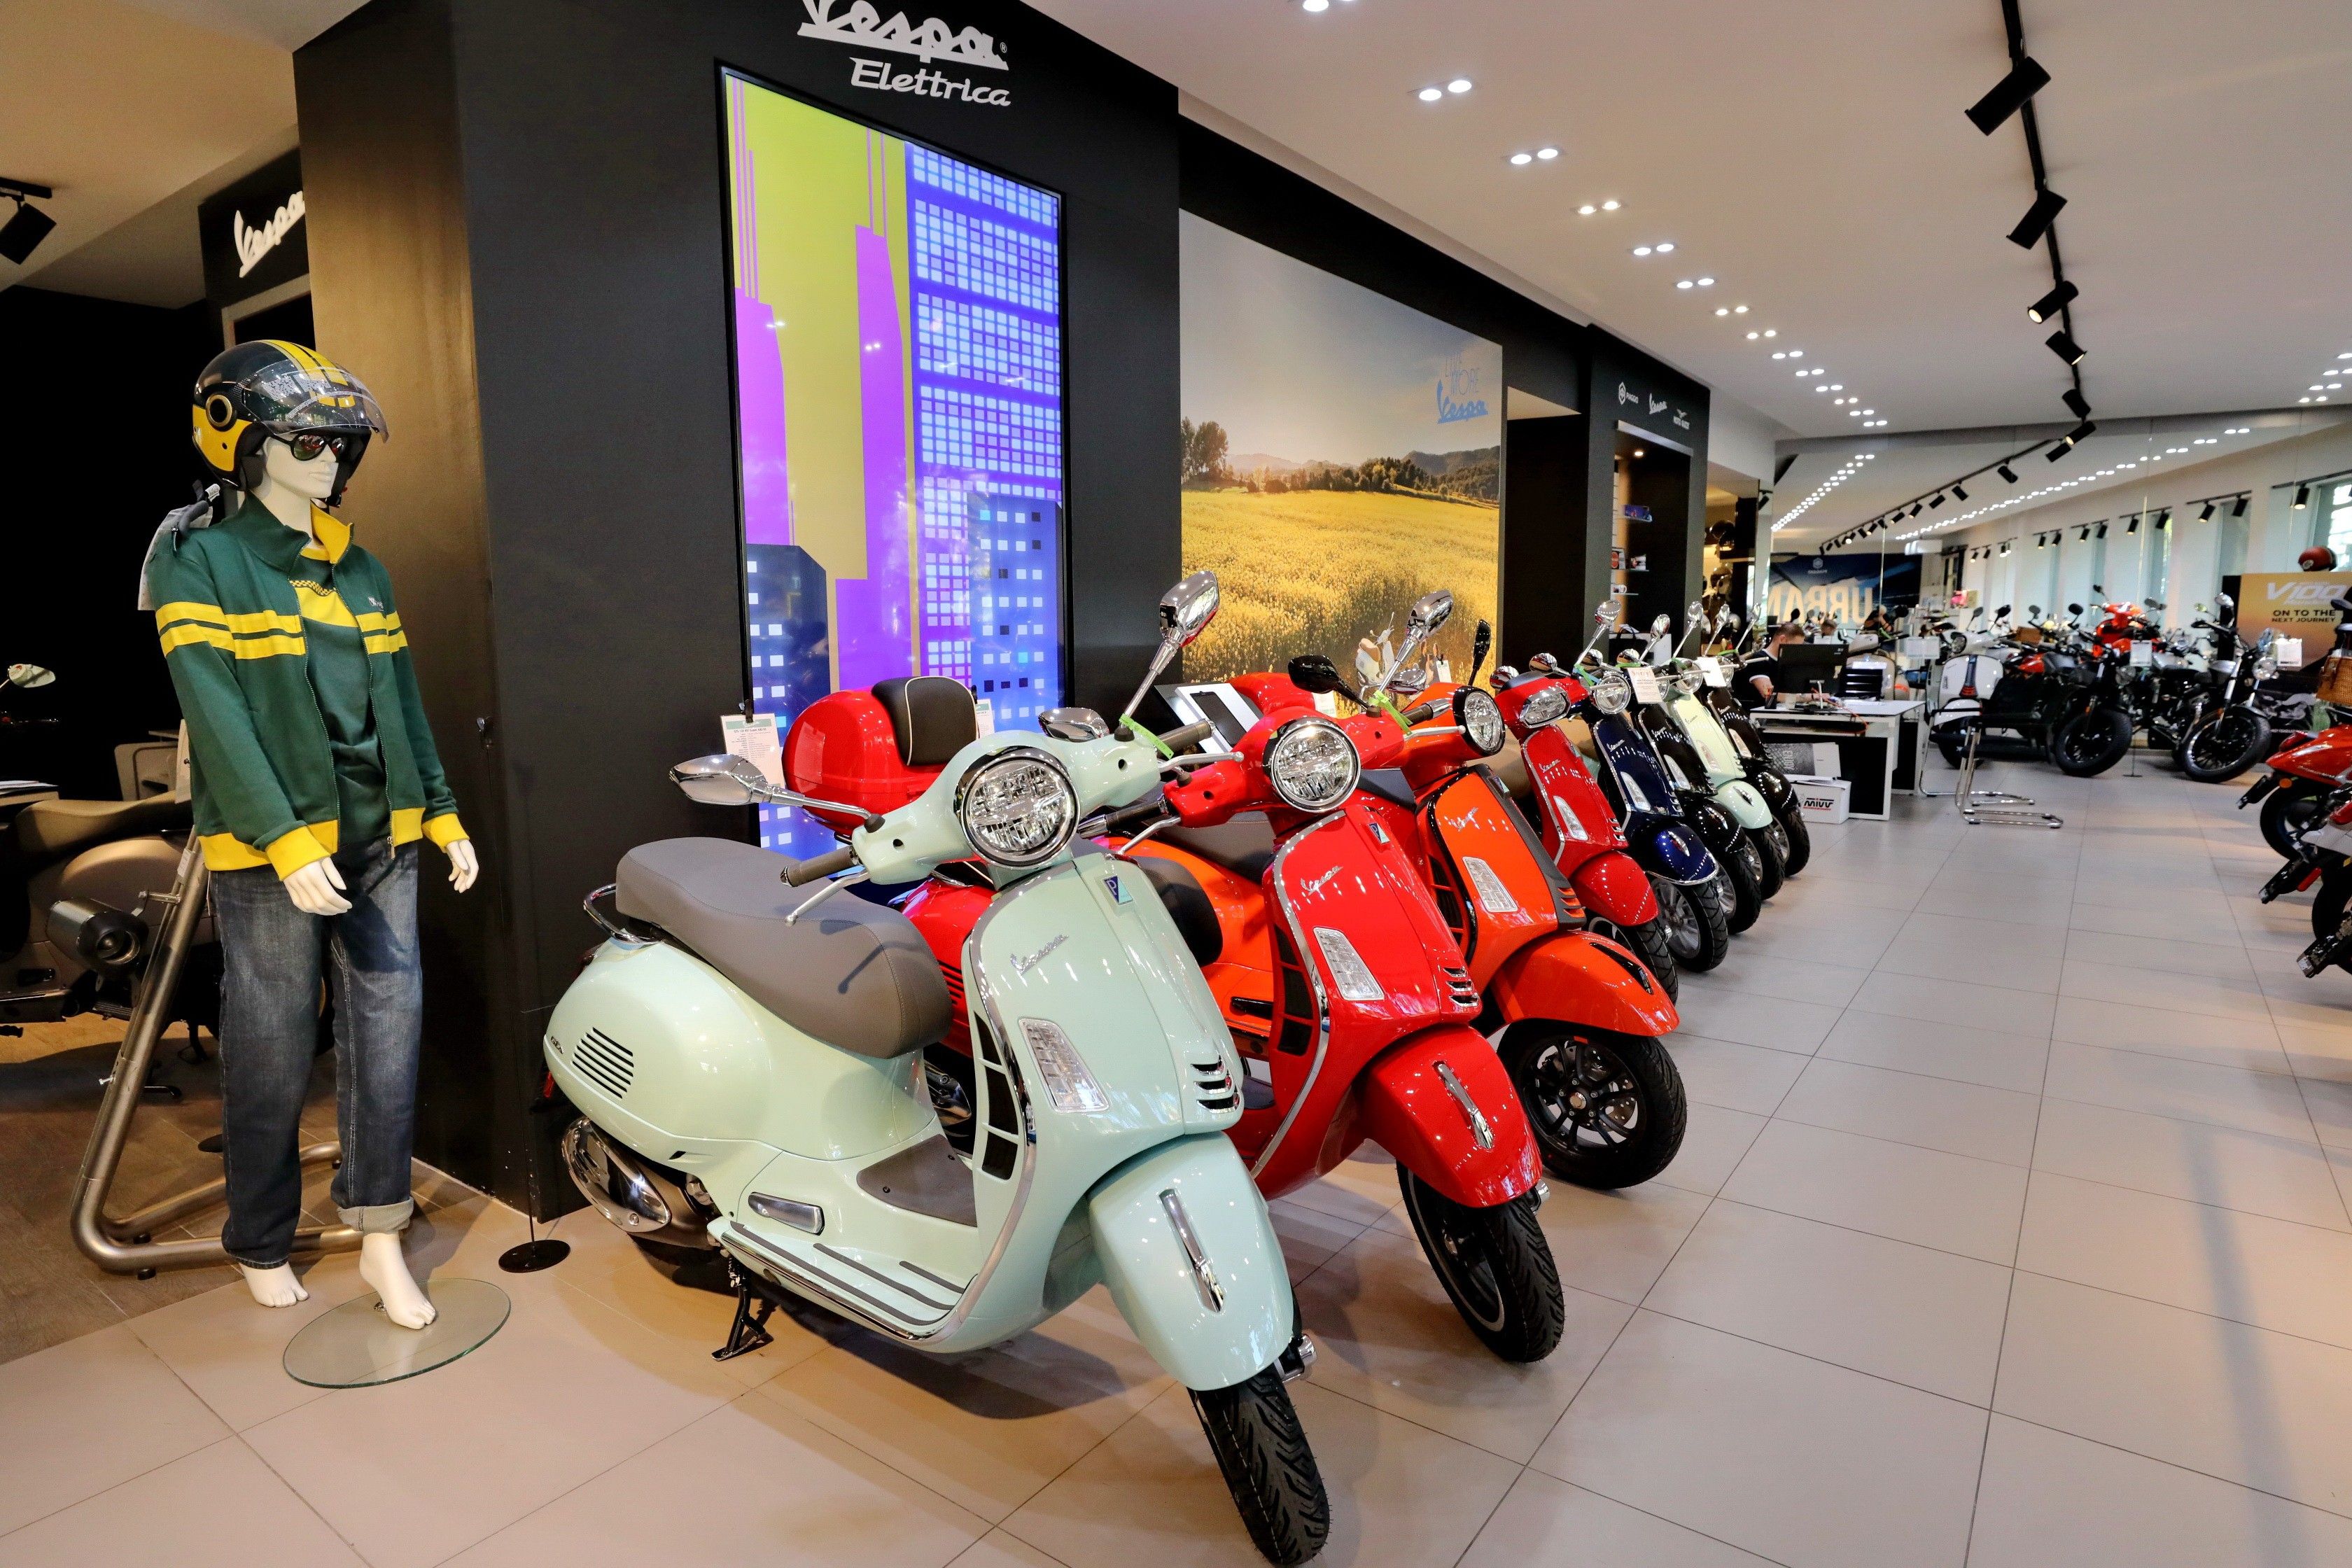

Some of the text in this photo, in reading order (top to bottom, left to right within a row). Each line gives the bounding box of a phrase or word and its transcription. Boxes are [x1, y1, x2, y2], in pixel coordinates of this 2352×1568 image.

[797, 0, 1009, 71] Vespa
[849, 57, 1011, 107] Elettrica
[234, 190, 305, 278] Vespa
[1436, 379, 1489, 424] Vespa
[1539, 759, 1560, 773] Vespa
[1301, 865, 1344, 896] Vespa
[1009, 934, 1069, 976] Vespa
